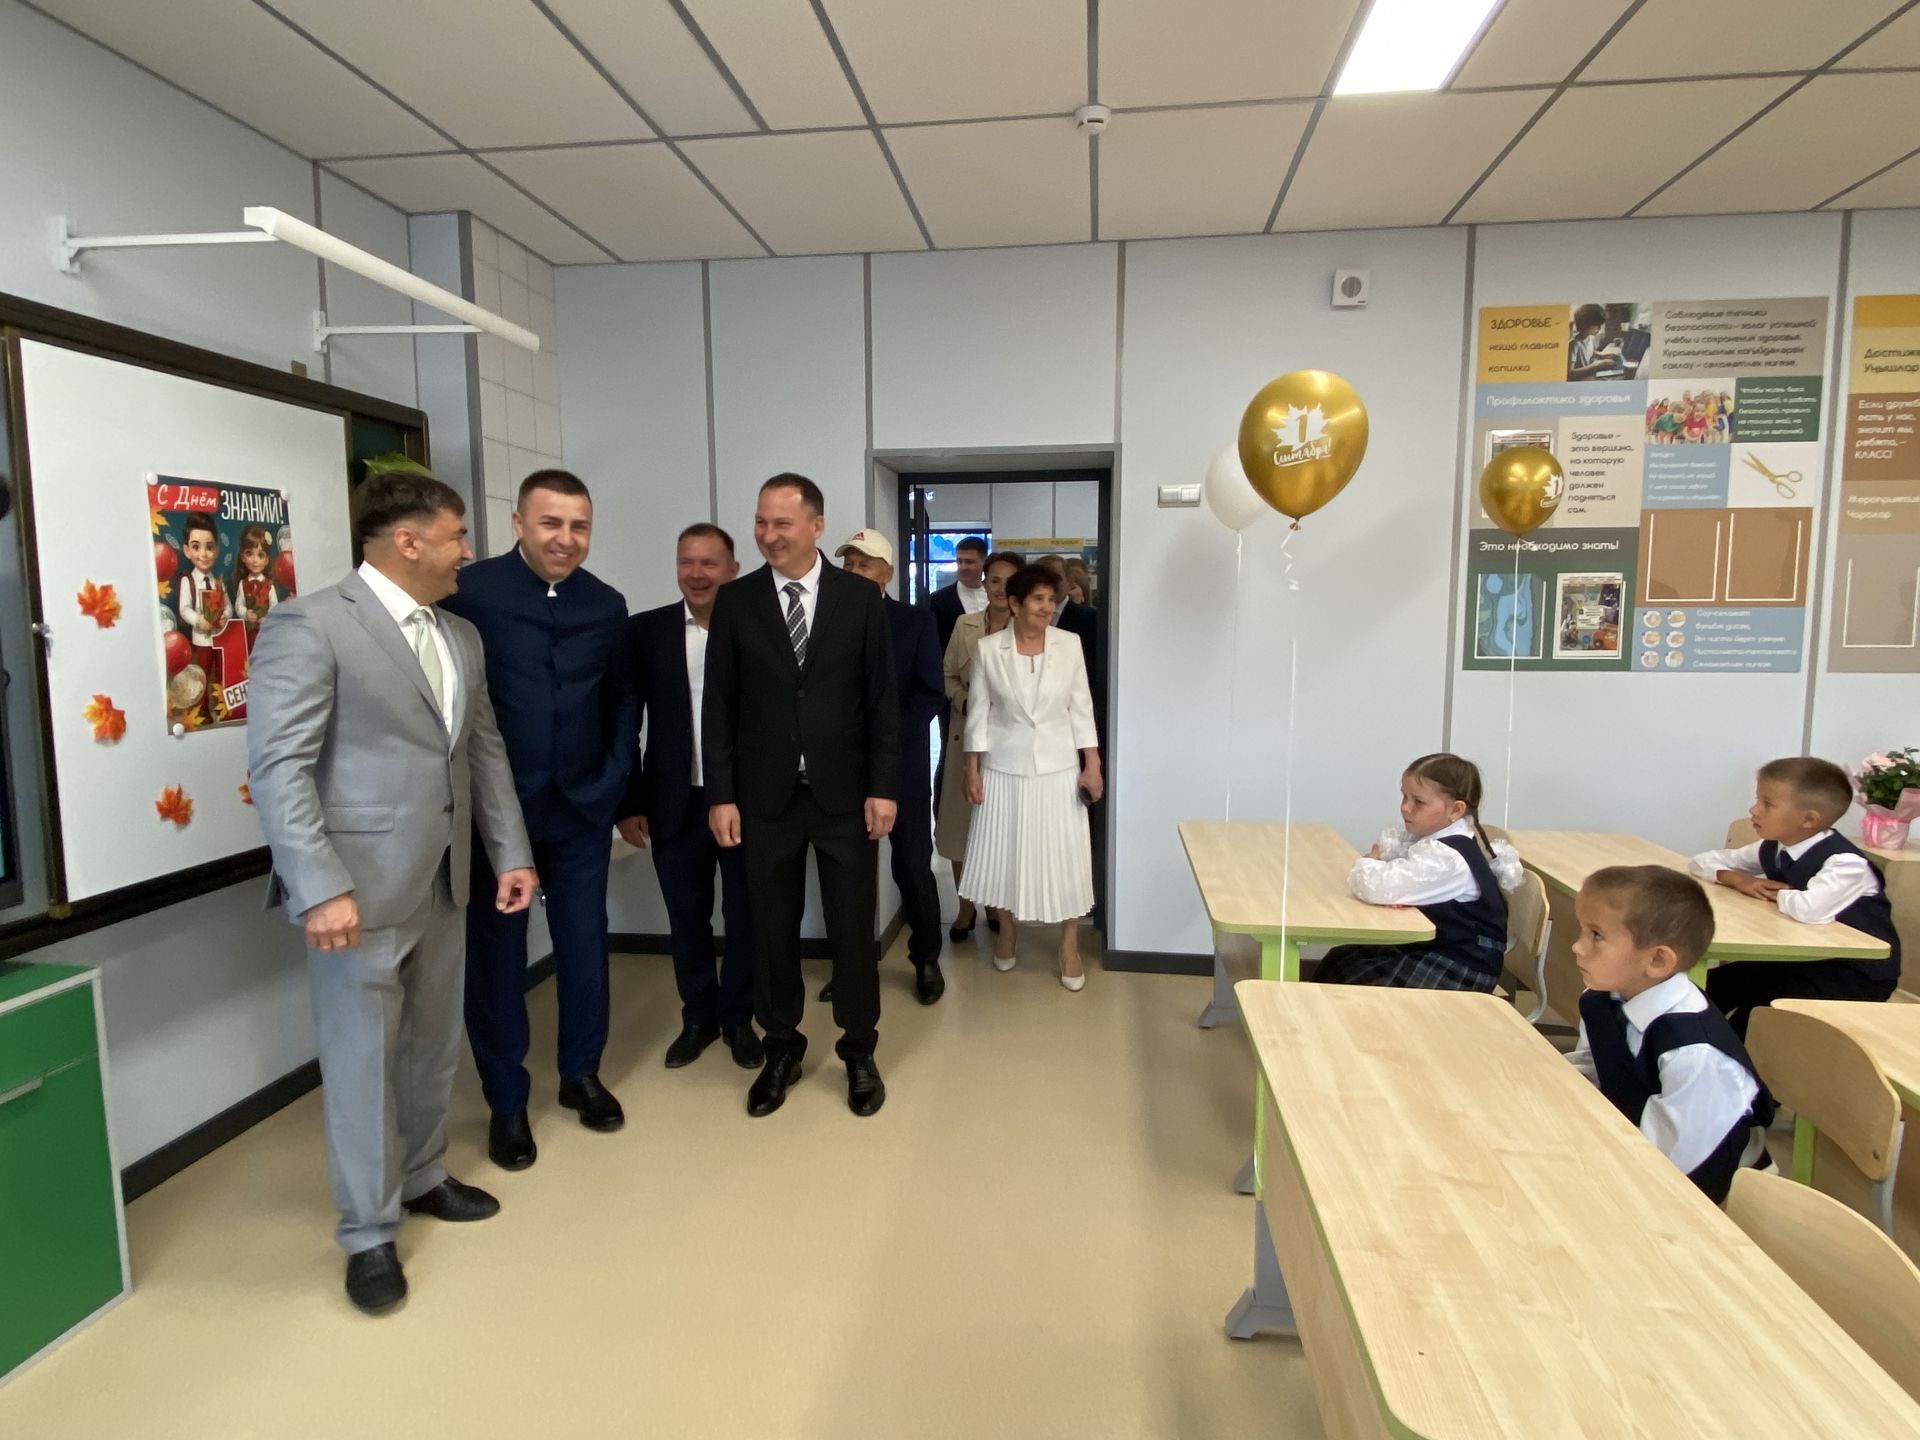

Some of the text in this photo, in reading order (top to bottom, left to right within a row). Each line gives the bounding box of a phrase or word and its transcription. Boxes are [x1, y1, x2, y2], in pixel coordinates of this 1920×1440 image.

[1490, 317, 1552, 330] ЗДОРОВЬЕ
[1488, 342, 1560, 352] наша главная
[1488, 364, 1531, 373] копилка
[1486, 394, 1632, 408] Профилактика здоровья
[1858, 398, 1920, 410] Если дружб
[1295, 414, 1308, 443] 1
[1571, 431, 1614, 441] Здоровье
[1273, 437, 1332, 466] Сентября!
[1582, 457, 1625, 466] которую
[1568, 483, 1604, 491] должен
[1567, 494, 1616, 503] подняться
[157, 484, 285, 525] С Днём ЗНАНИЙ!
[1479, 541, 1505, 551] Это
[1582, 540, 1619, 551] знать!
[225, 682, 248, 707] СЕН
